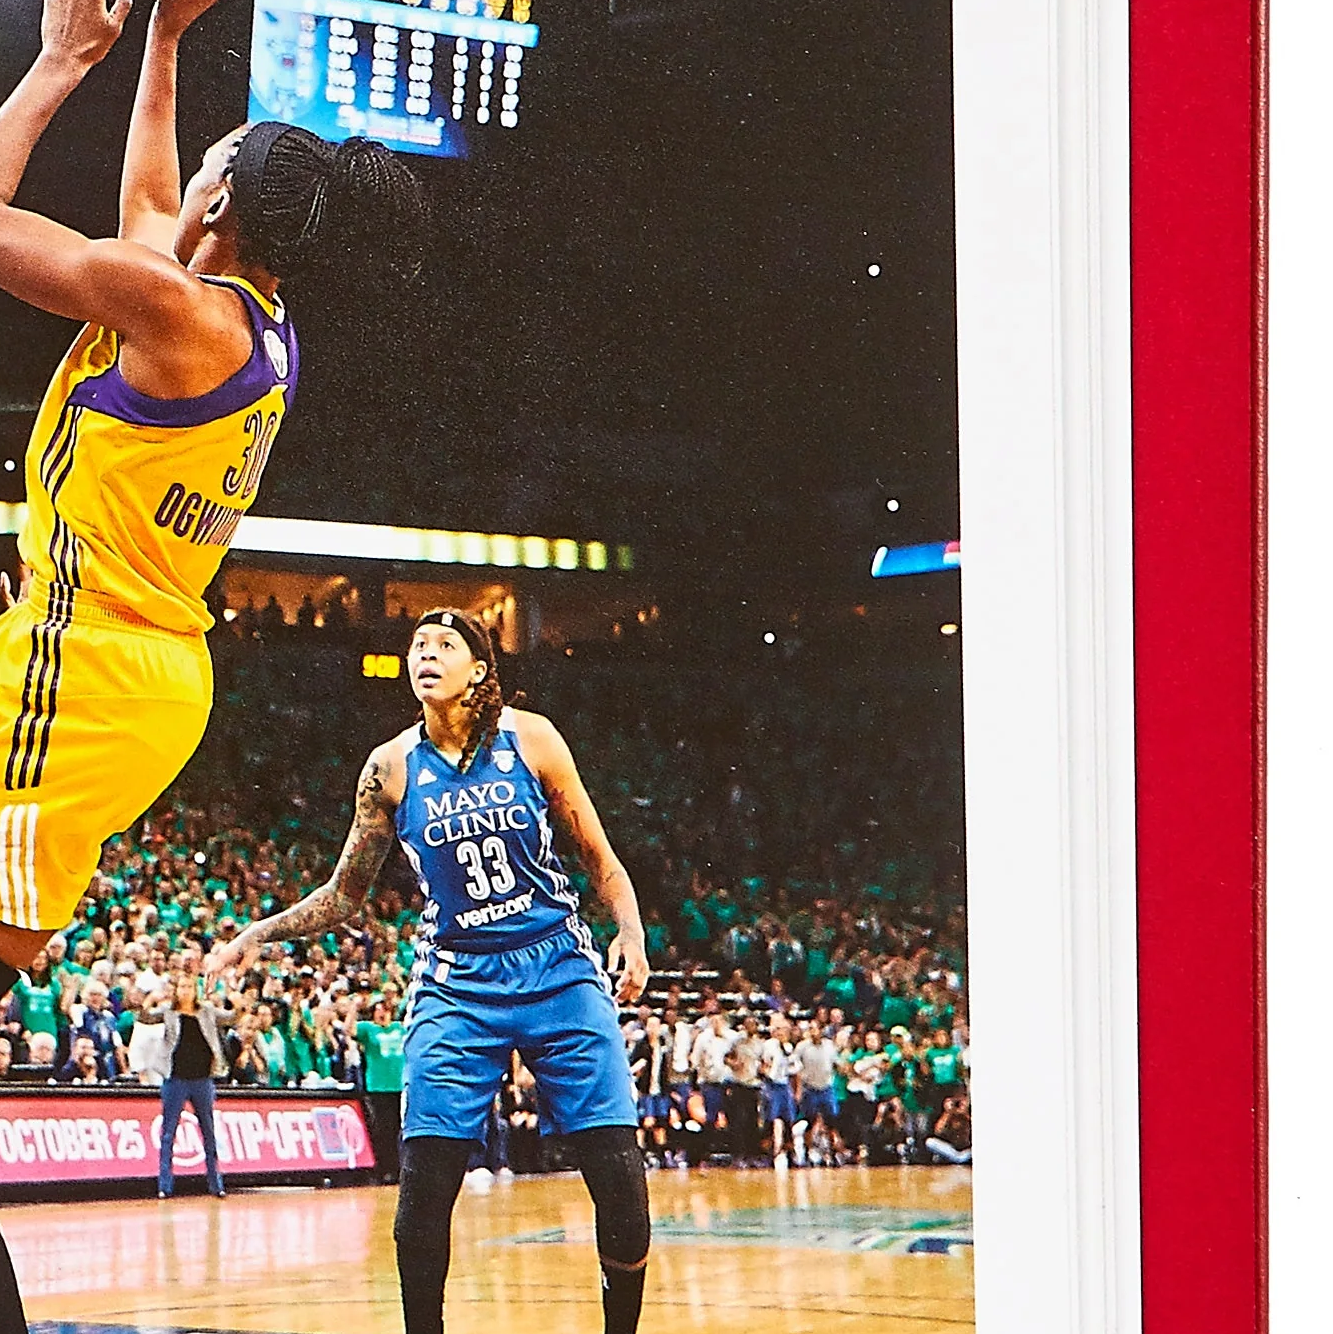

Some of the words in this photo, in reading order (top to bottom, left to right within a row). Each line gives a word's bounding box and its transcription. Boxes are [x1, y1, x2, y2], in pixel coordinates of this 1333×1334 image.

[423, 780, 516, 821] MAYO
[423, 805, 530, 847] CLINIC
[455, 835, 516, 901] 33
[454, 892, 533, 930] verizon
[110, 1120, 147, 1161] 25
